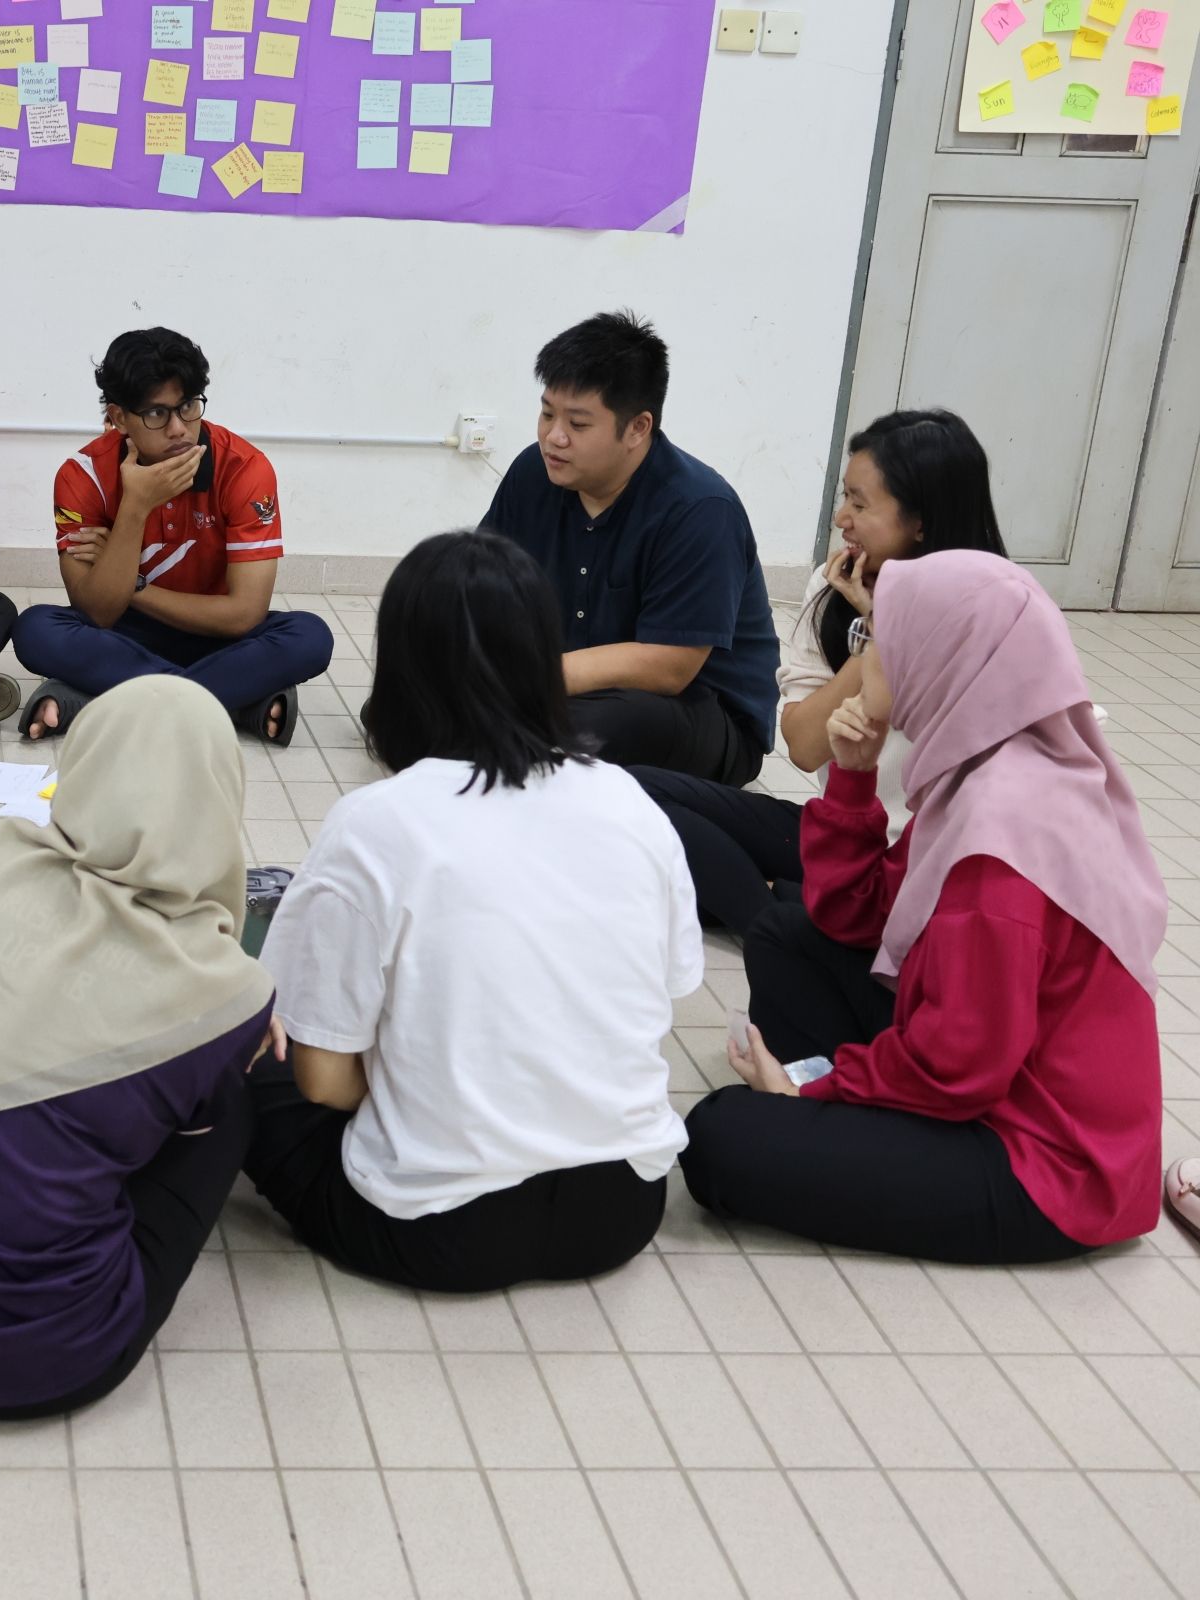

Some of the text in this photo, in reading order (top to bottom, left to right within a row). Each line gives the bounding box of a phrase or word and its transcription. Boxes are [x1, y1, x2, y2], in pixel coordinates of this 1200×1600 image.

[14, 29, 21, 37] is
[21, 78, 44, 86] human
[983, 97, 1006, 109] Sun
